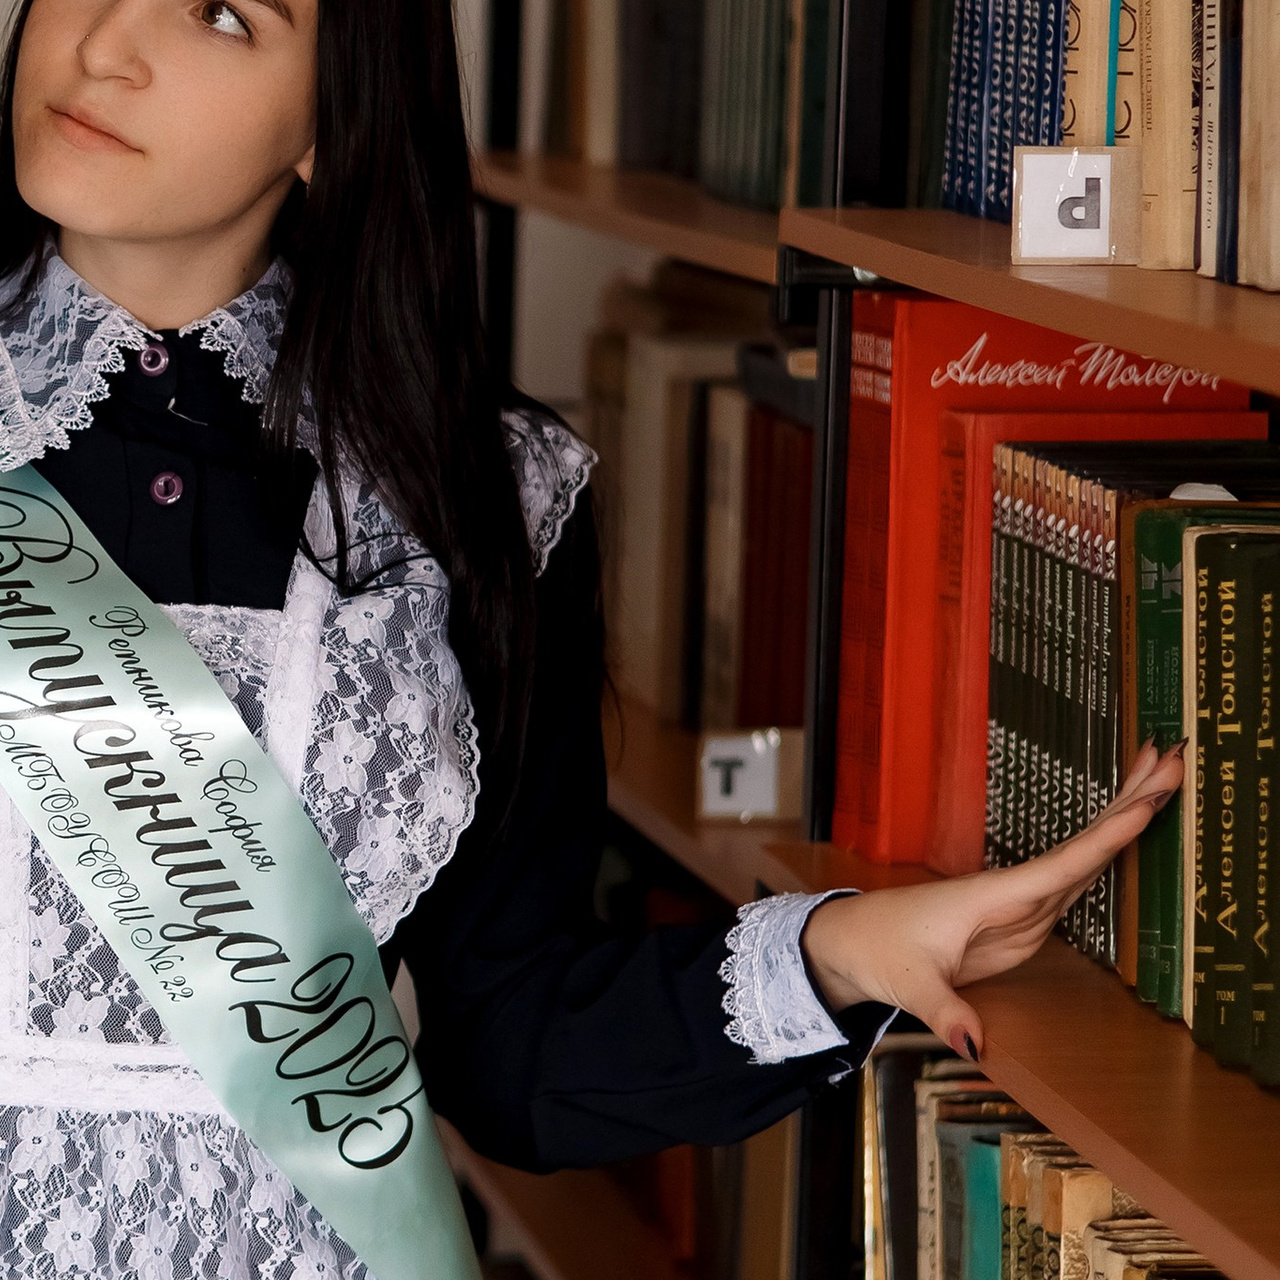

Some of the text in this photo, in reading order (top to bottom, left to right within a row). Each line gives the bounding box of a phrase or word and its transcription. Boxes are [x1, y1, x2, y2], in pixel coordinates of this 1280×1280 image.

[88, 604, 277, 874] Репникова София
[709, 756, 745, 797] Т
[1214, 578, 1242, 942] Алексей Толстой
[159, 974, 195, 1003] 22
[227, 951, 427, 1170] 2025
